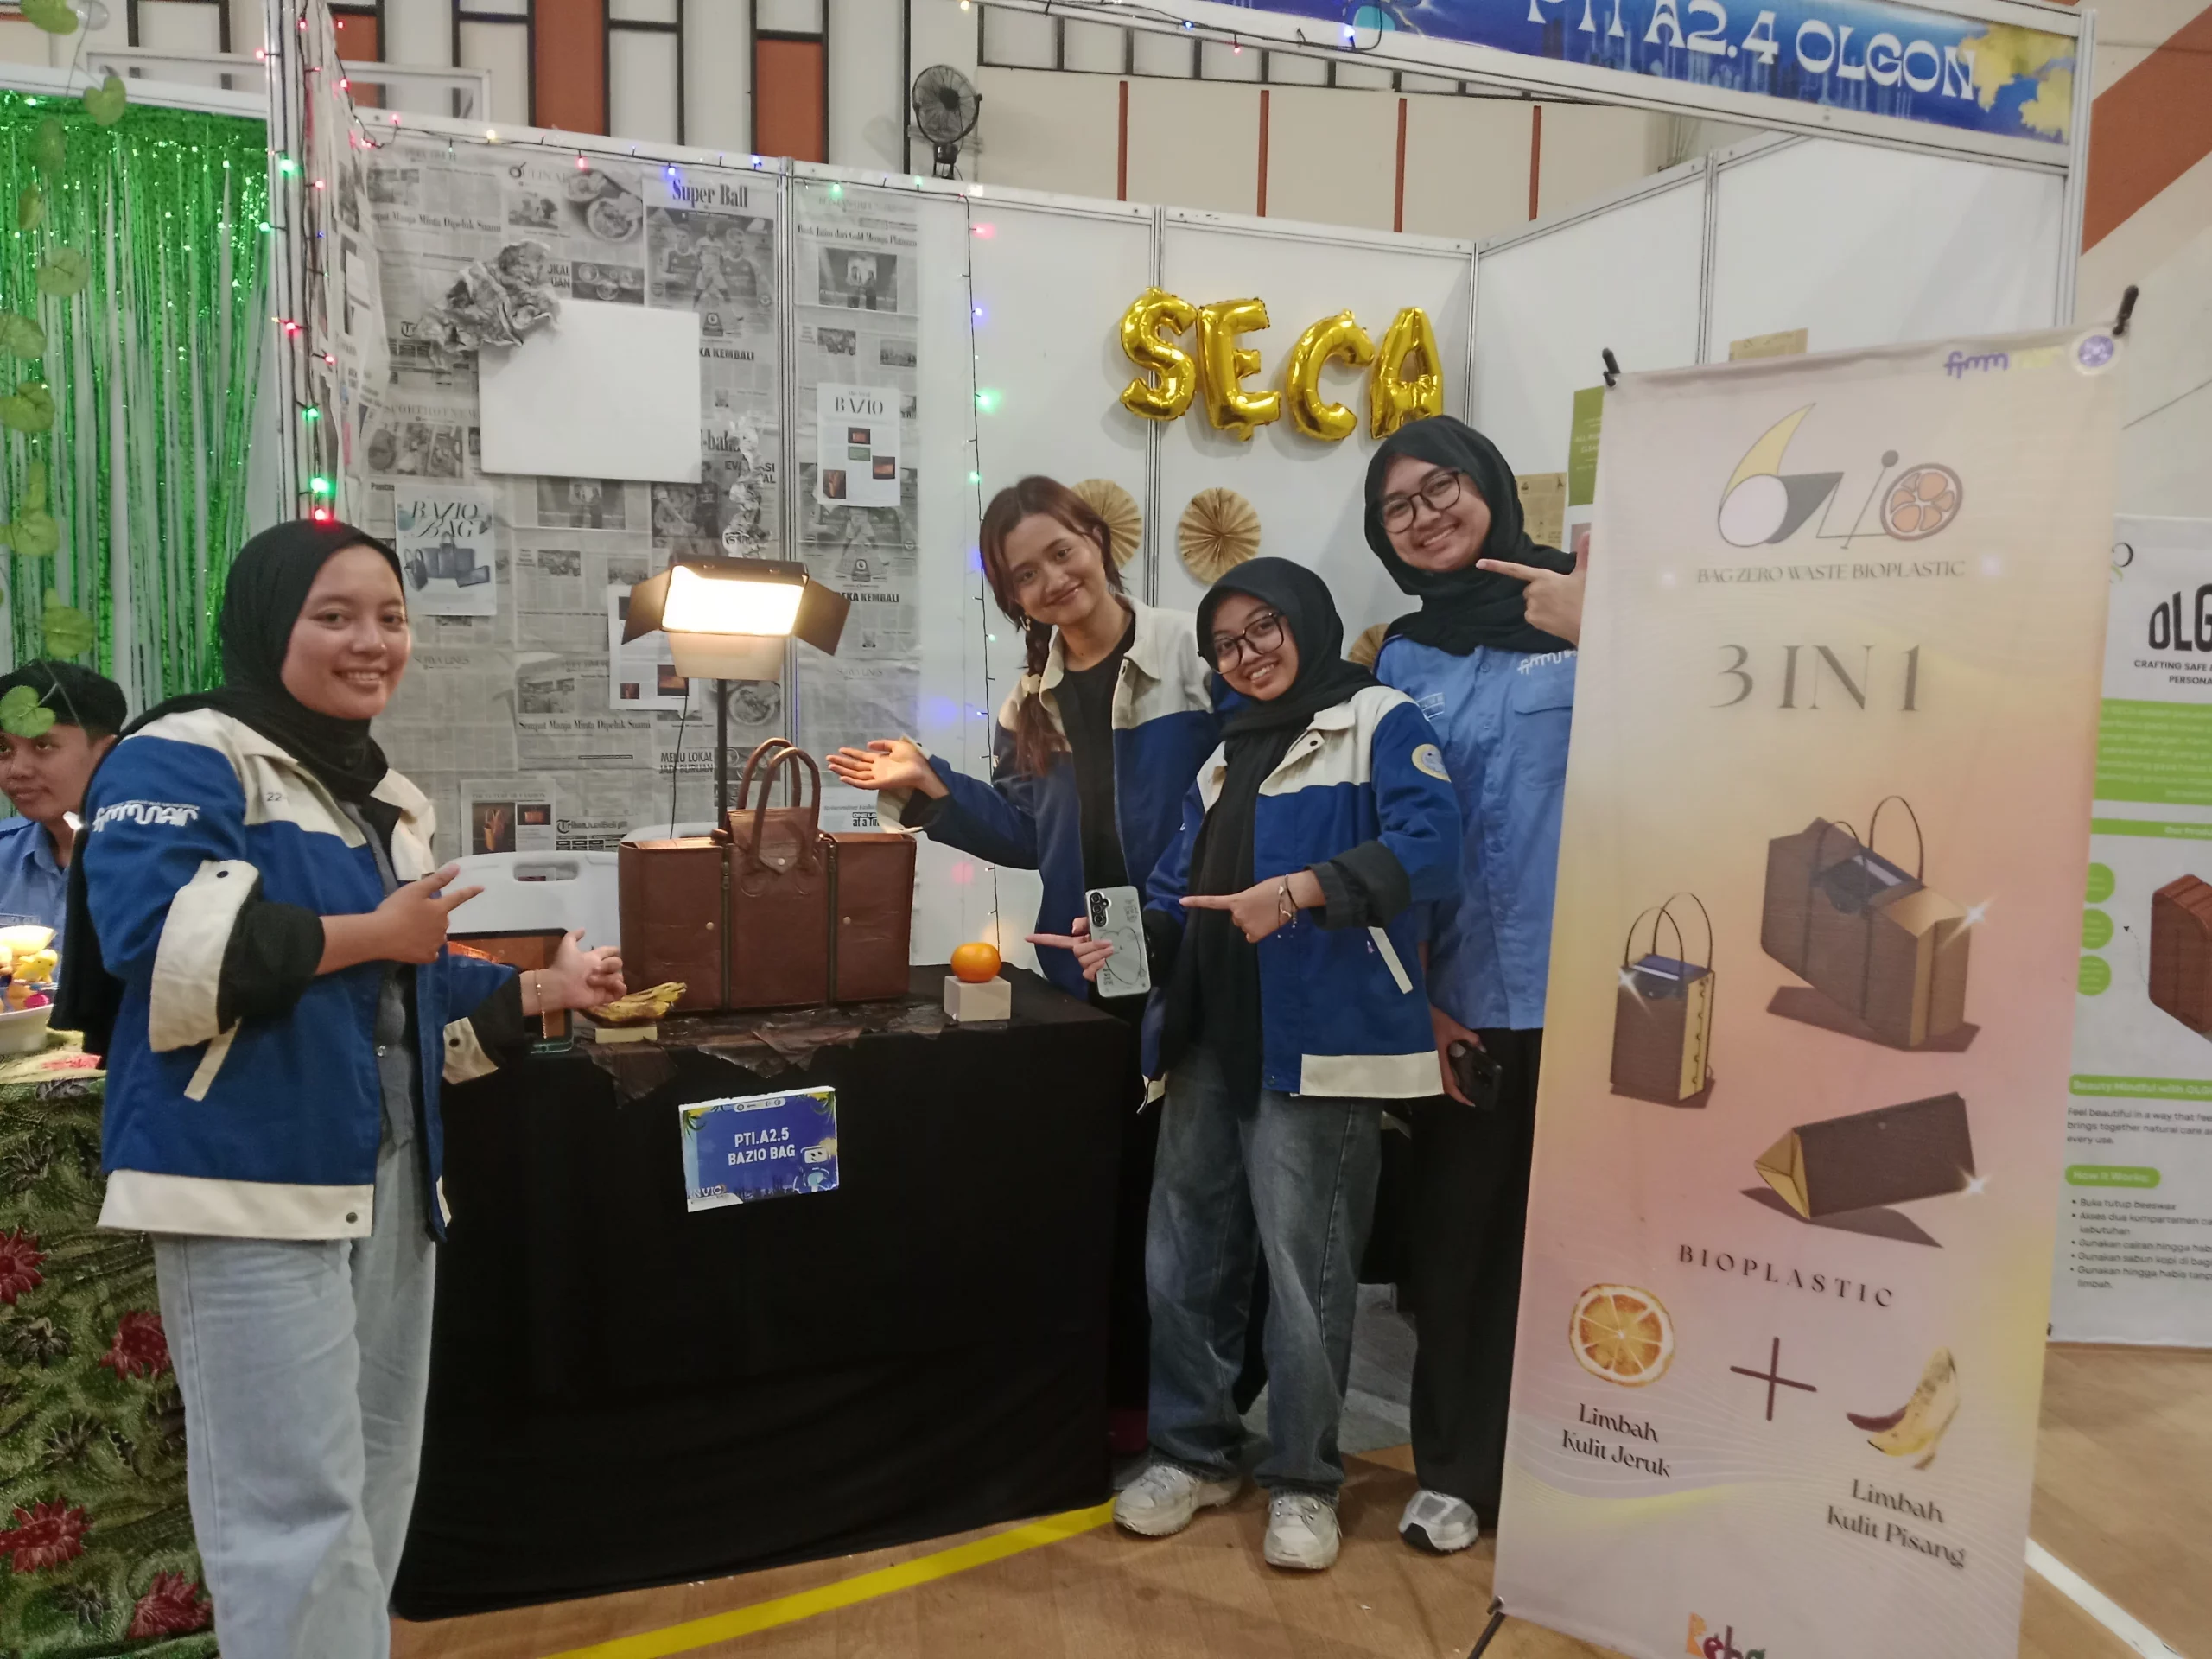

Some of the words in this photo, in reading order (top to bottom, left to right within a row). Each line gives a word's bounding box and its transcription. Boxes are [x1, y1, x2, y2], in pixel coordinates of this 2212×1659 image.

[1643, 0, 1779, 64] A2.4
[1796, 20, 1974, 100] OLGON
[672, 178, 715, 208] Super
[720, 183, 748, 208] Ball
[713, 348, 754, 361] KEMBALI
[1120, 286, 1443, 442] SECA
[1697, 568, 1733, 583] BAG
[1737, 566, 1783, 582] ZERO
[1789, 563, 1847, 580] WASTE
[1852, 561, 1966, 580] BIOPLASTIC
[861, 593, 899, 603] KEMBALI
[2133, 659, 2182, 671] CRAFTING
[2184, 662, 2208, 671] SAFE
[1709, 644, 1753, 709] 3
[1777, 644, 1876, 710] IN
[1897, 644, 1921, 712] 1
[688, 752, 713, 762] LOKAL
[679, 764, 714, 773] BURUAN
[2067, 1107, 2087, 1116] Feel
[2088, 1108, 2133, 1118] beautiful
[2133, 1110, 2143, 1119] in
[2152, 1113, 2171, 1122] way
[2174, 1112, 2195, 1122] that
[2067, 1121, 2098, 1132] brings
[2100, 1122, 2140, 1133] together
[2143, 1124, 2178, 1134] natural
[2180, 1127, 2202, 1135] care
[734, 1126, 790, 1148] PTI.A2.5
[2066, 1135, 2094, 1145] every
[2094, 1136, 2115, 1145] use.
[728, 1147, 767, 1166] BAZIO
[769, 1143, 796, 1160] BAG
[2080, 1198, 2102, 1207] Buka
[2104, 1199, 2133, 1210] tutup
[2107, 1213, 2127, 1222] dua
[2156, 1242, 2190, 1253] hingga
[2077, 1251, 2121, 1262] Gunakan
[2122, 1253, 2153, 1263] sabun
[2179, 1255, 2190, 1265] di
[1678, 1243, 1893, 1308] BIOPLASTIC
[2077, 1265, 2121, 1275] Gunakan
[2122, 1267, 2158, 1279] hingga
[2159, 1268, 2187, 1279] habis
[1579, 1402, 1659, 1443] Limbah
[1562, 1428, 1607, 1460] Kulit
[1611, 1446, 1670, 1478] Jeruk
[1852, 1478, 1944, 1523] Limbah
[1827, 1505, 1878, 1539] Kulit
[1885, 1522, 1967, 1569] Pisang
